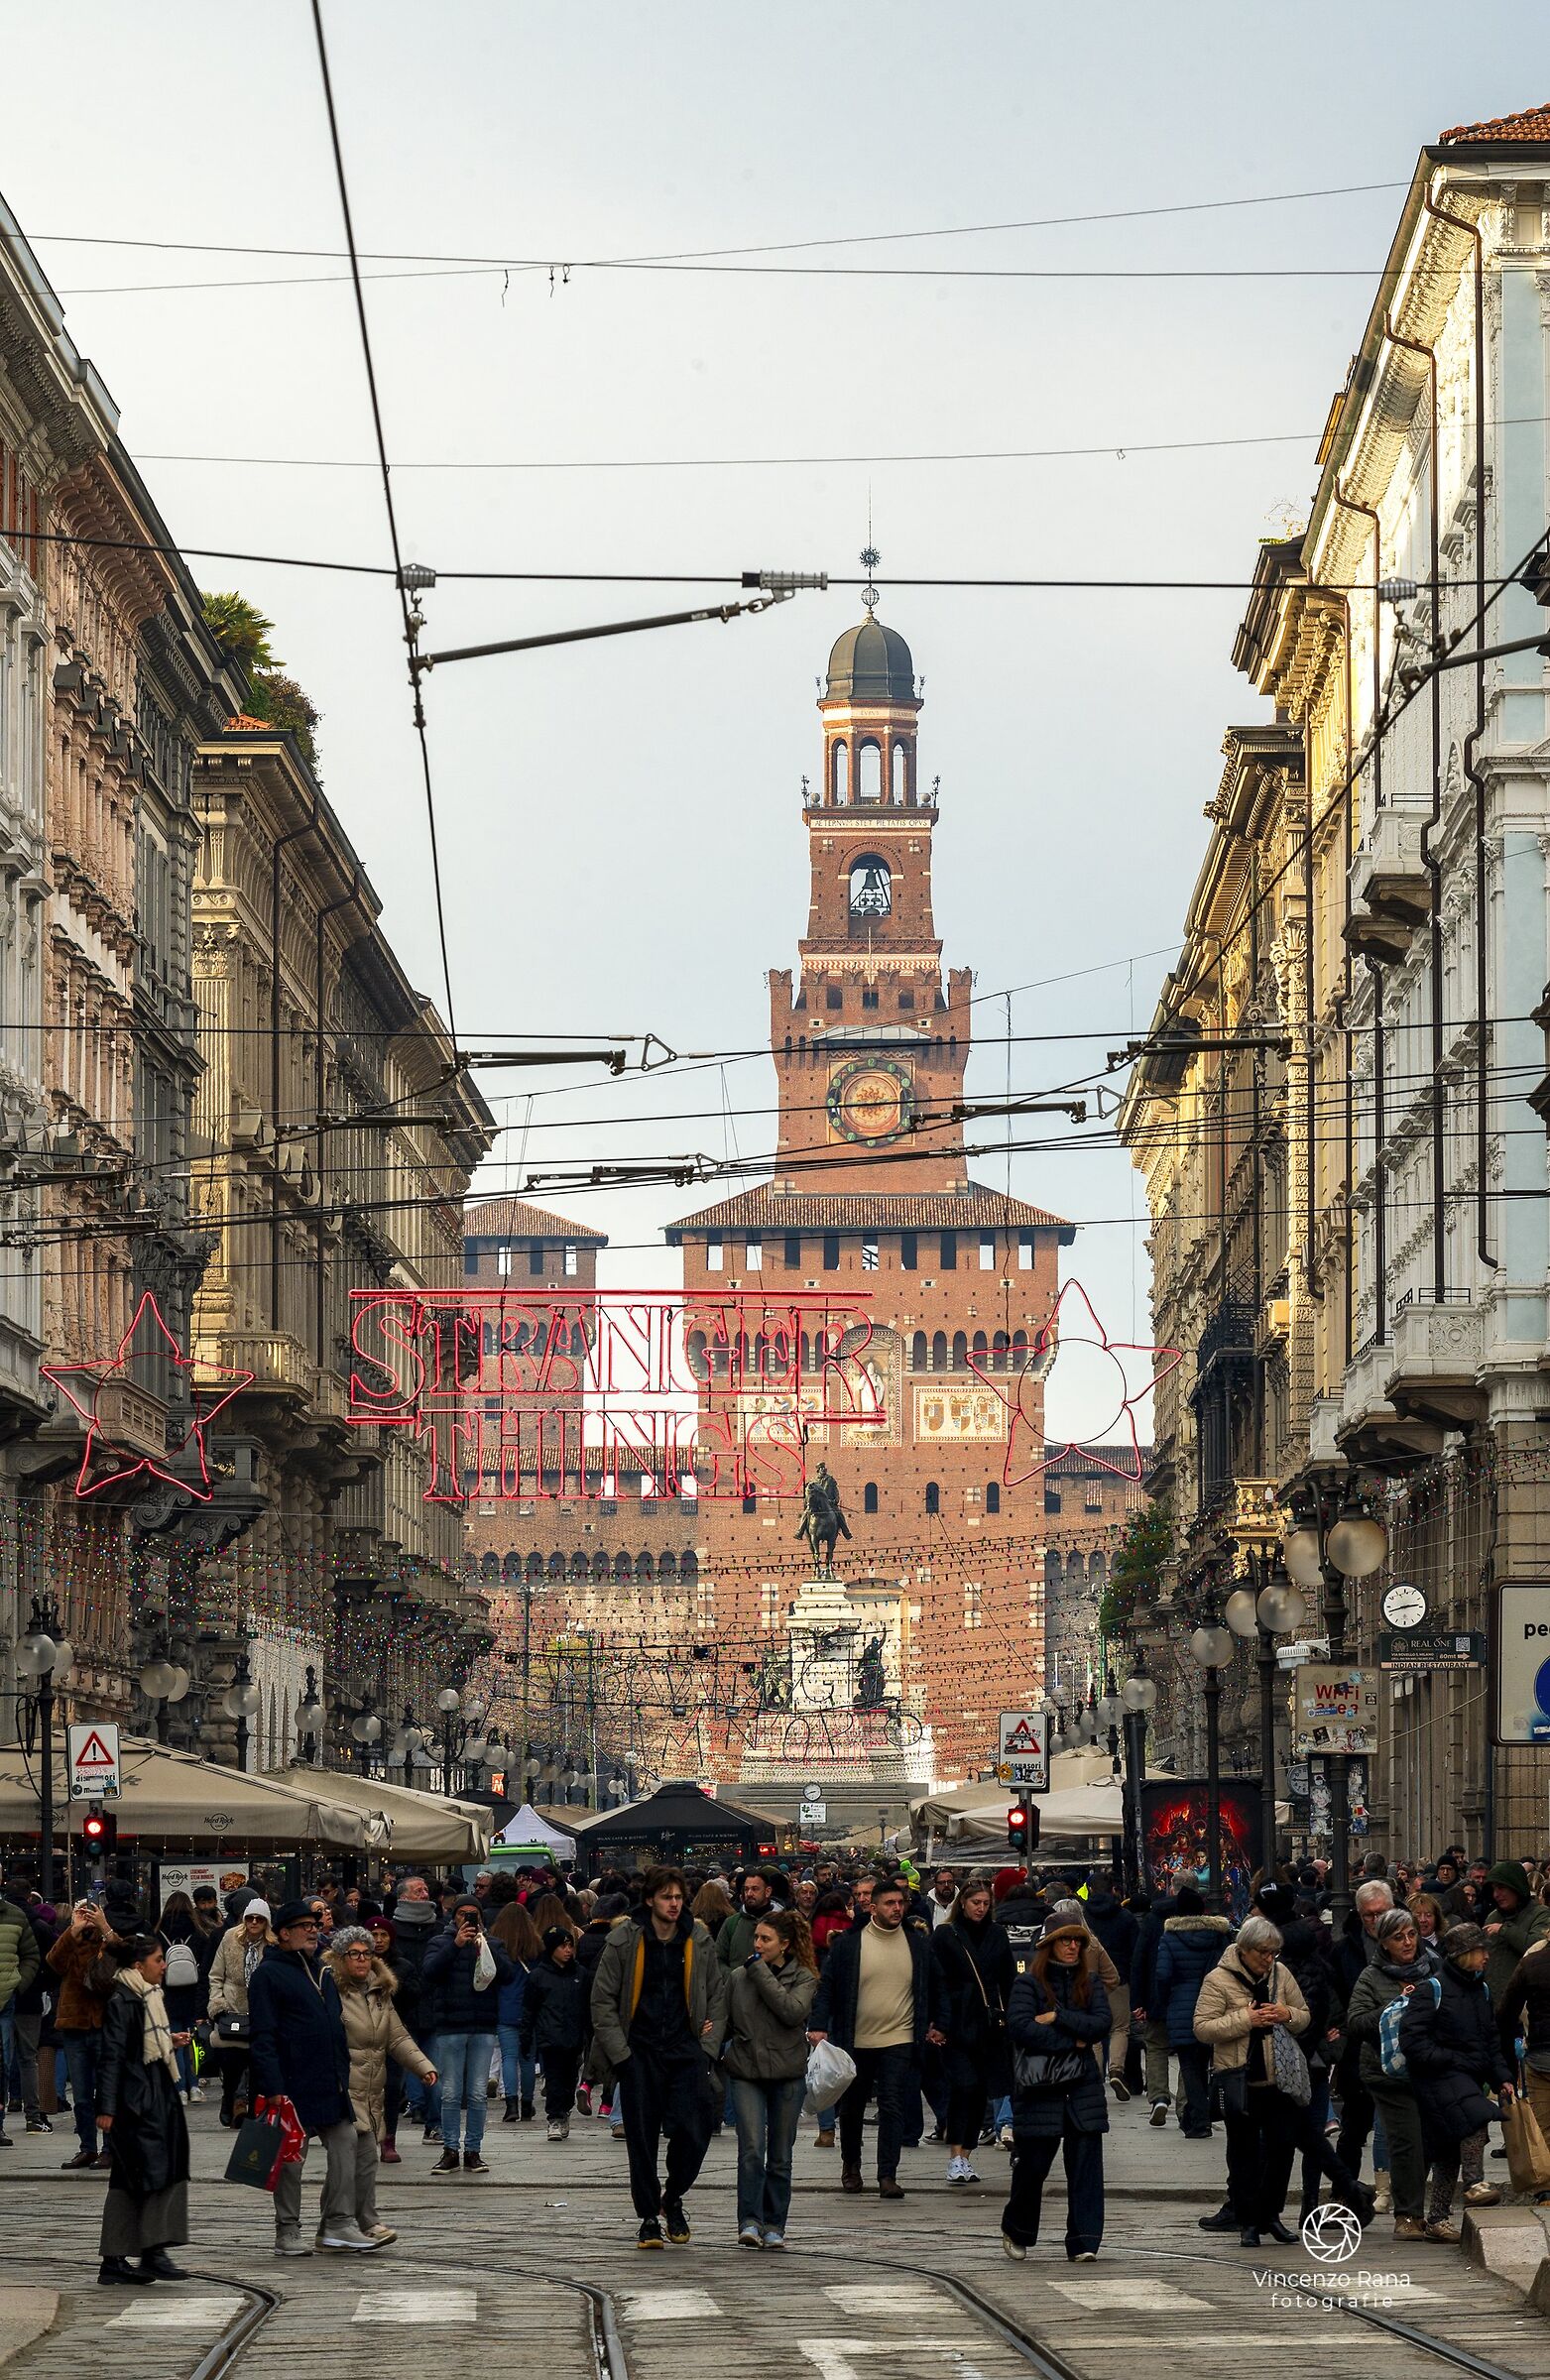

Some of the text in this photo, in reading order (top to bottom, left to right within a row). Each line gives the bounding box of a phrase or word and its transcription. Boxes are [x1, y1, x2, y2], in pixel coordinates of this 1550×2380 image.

[350, 1297, 886, 1416] STRANGER
[415, 1408, 806, 1501] THINGS
[1411, 1639, 1431, 1648] REAL
